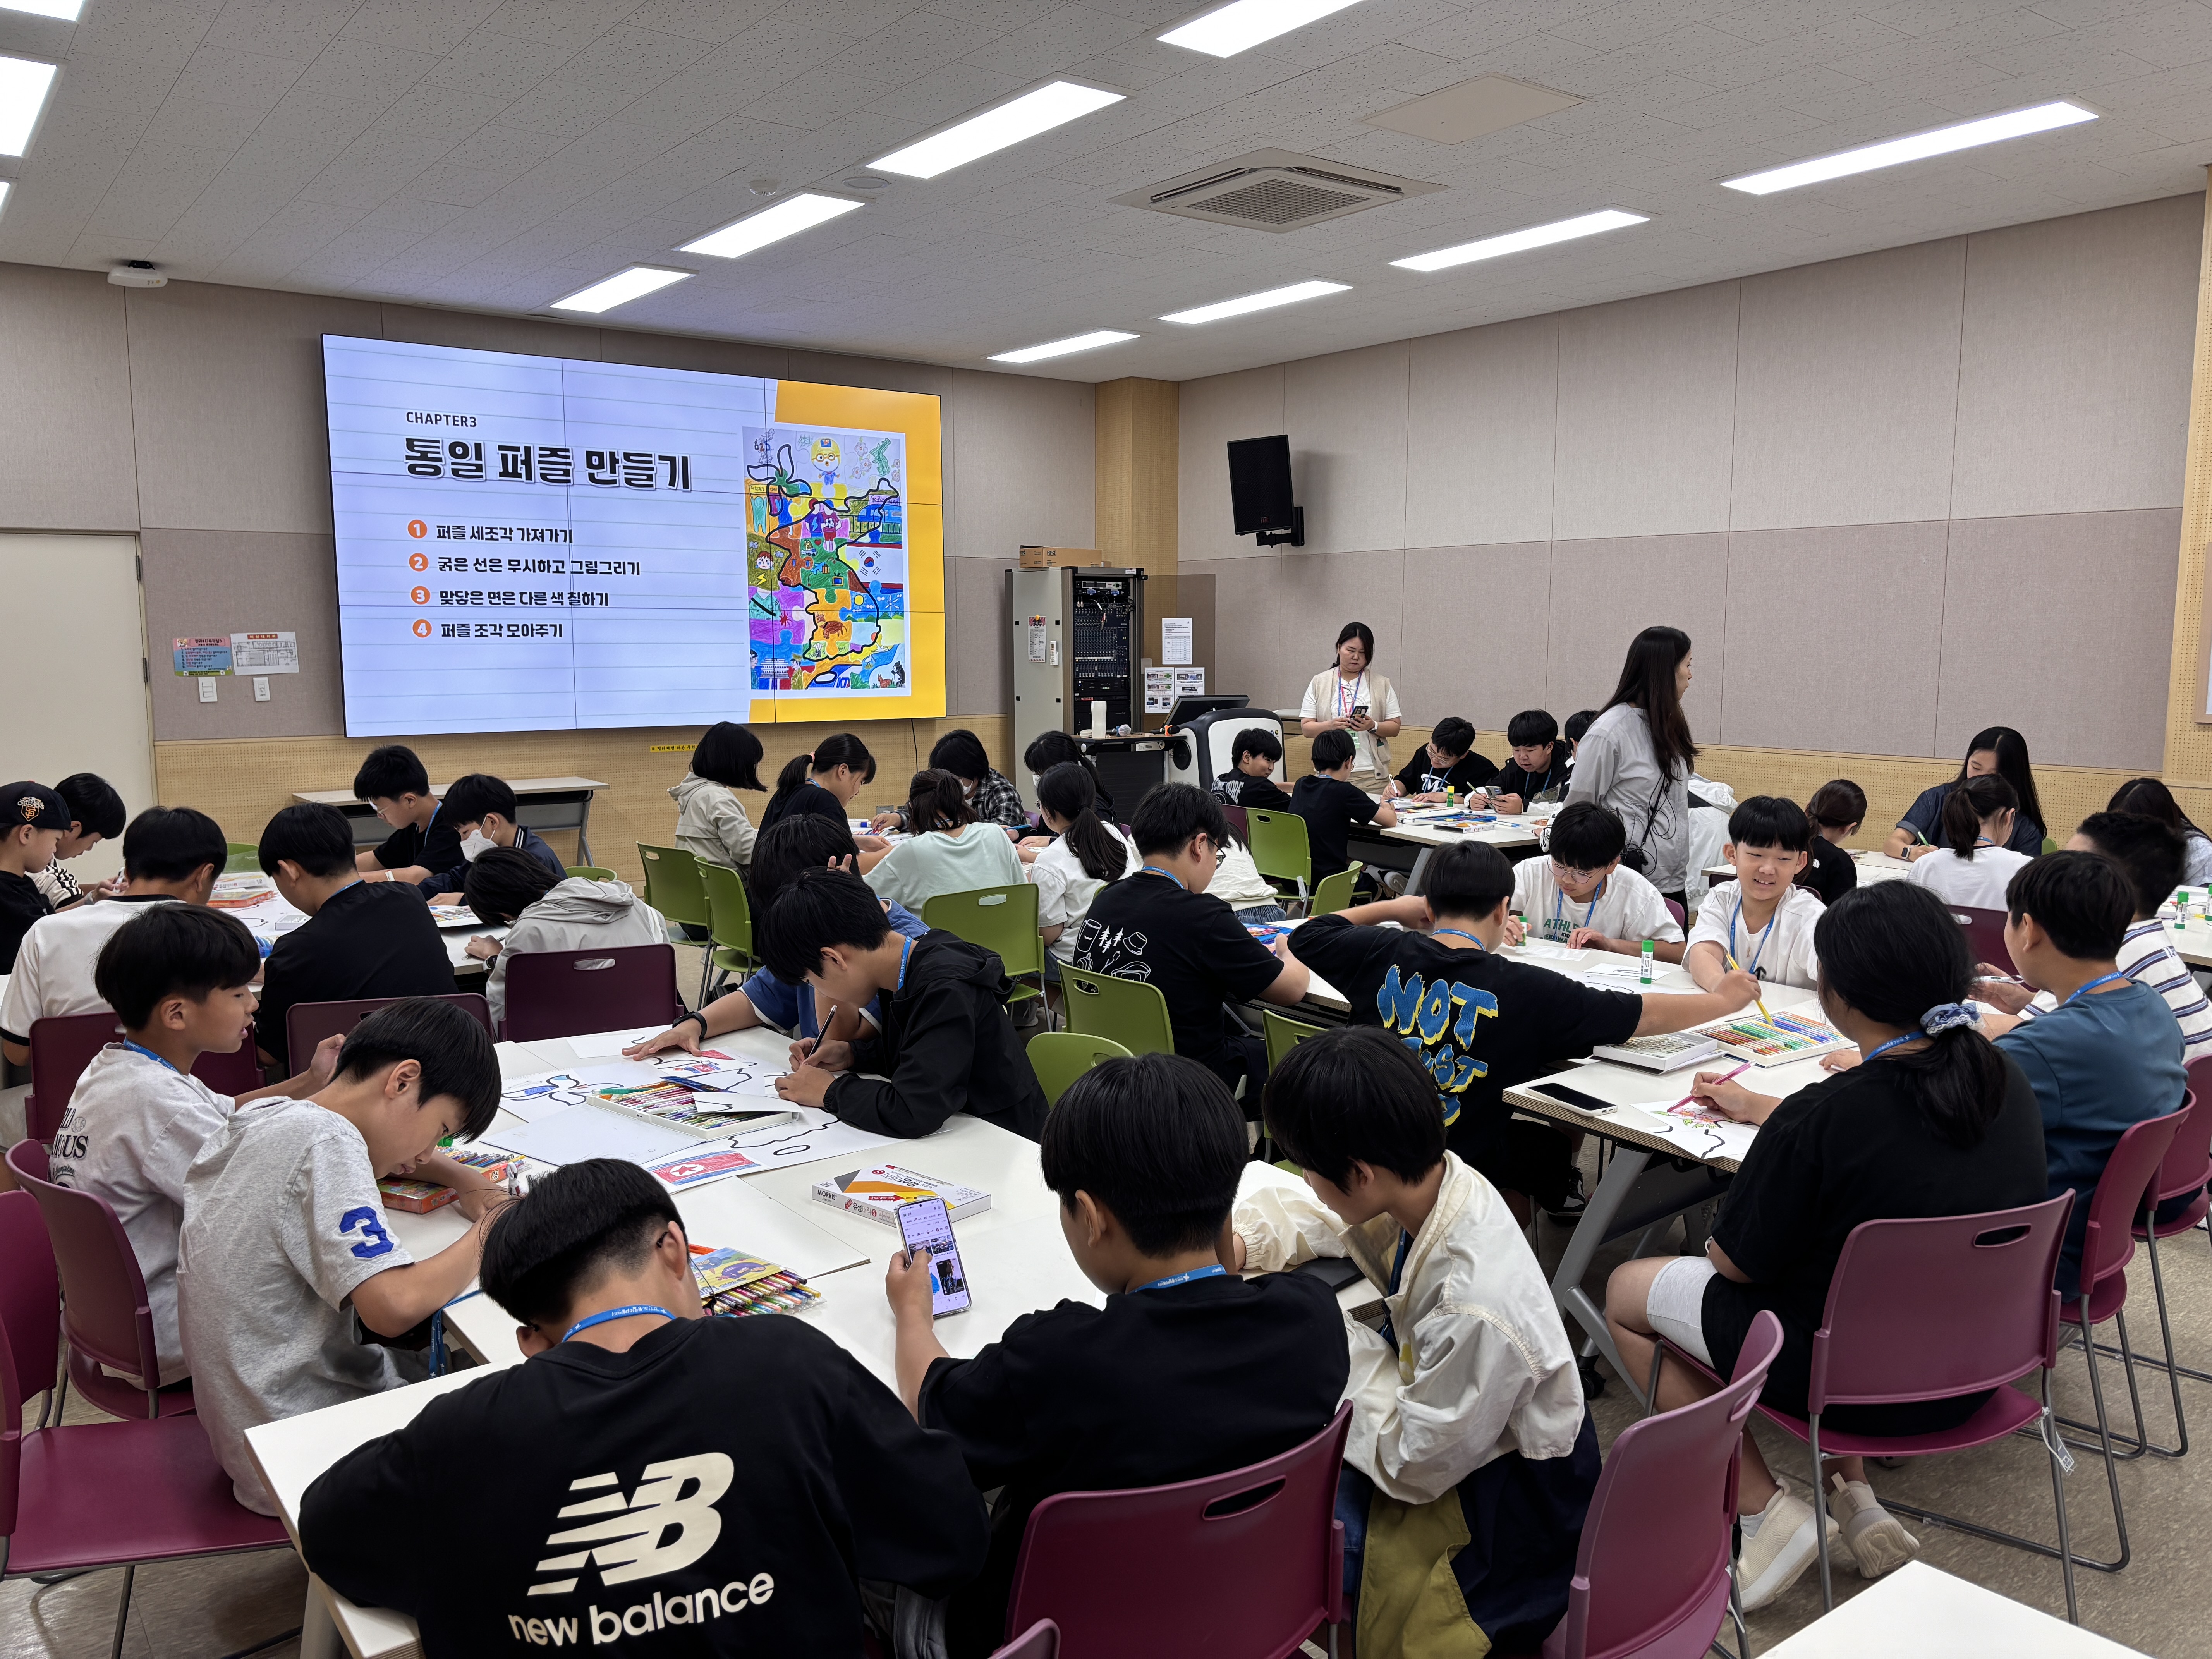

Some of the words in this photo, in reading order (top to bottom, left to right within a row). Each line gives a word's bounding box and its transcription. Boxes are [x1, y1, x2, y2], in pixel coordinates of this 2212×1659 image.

[406, 412, 477, 428] CHAPTER3
[405, 437, 486, 480] 통일
[497, 444, 573, 485] 퍼즐
[586, 449, 691, 491] 만들기
[436, 525, 466, 540] 퍼즐
[470, 526, 514, 541] 세조각
[517, 527, 572, 543] 가져가기
[438, 556, 468, 572] 굵은
[473, 557, 502, 572] 선은
[507, 559, 565, 574] 무시하고
[570, 560, 640, 575] 그림그리기
[440, 591, 484, 605] 맞닿은
[488, 591, 515, 605] 면은
[519, 591, 547, 606] 다른
[550, 591, 564, 606] 색
[567, 592, 608, 606] 칠하기
[441, 623, 470, 638] 퍼즐
[474, 624, 503, 638] 조각
[507, 624, 562, 638] 모아주기
[1377, 964, 1498, 1050] NOT
[492, 1170, 499, 1181] 50
[817, 1189, 836, 1200] MORRIS
[853, 1202, 871, 1216] 유성매직
[339, 1206, 394, 1258] 3
[508, 1614, 578, 1646] new
[589, 1572, 774, 1645] balance
